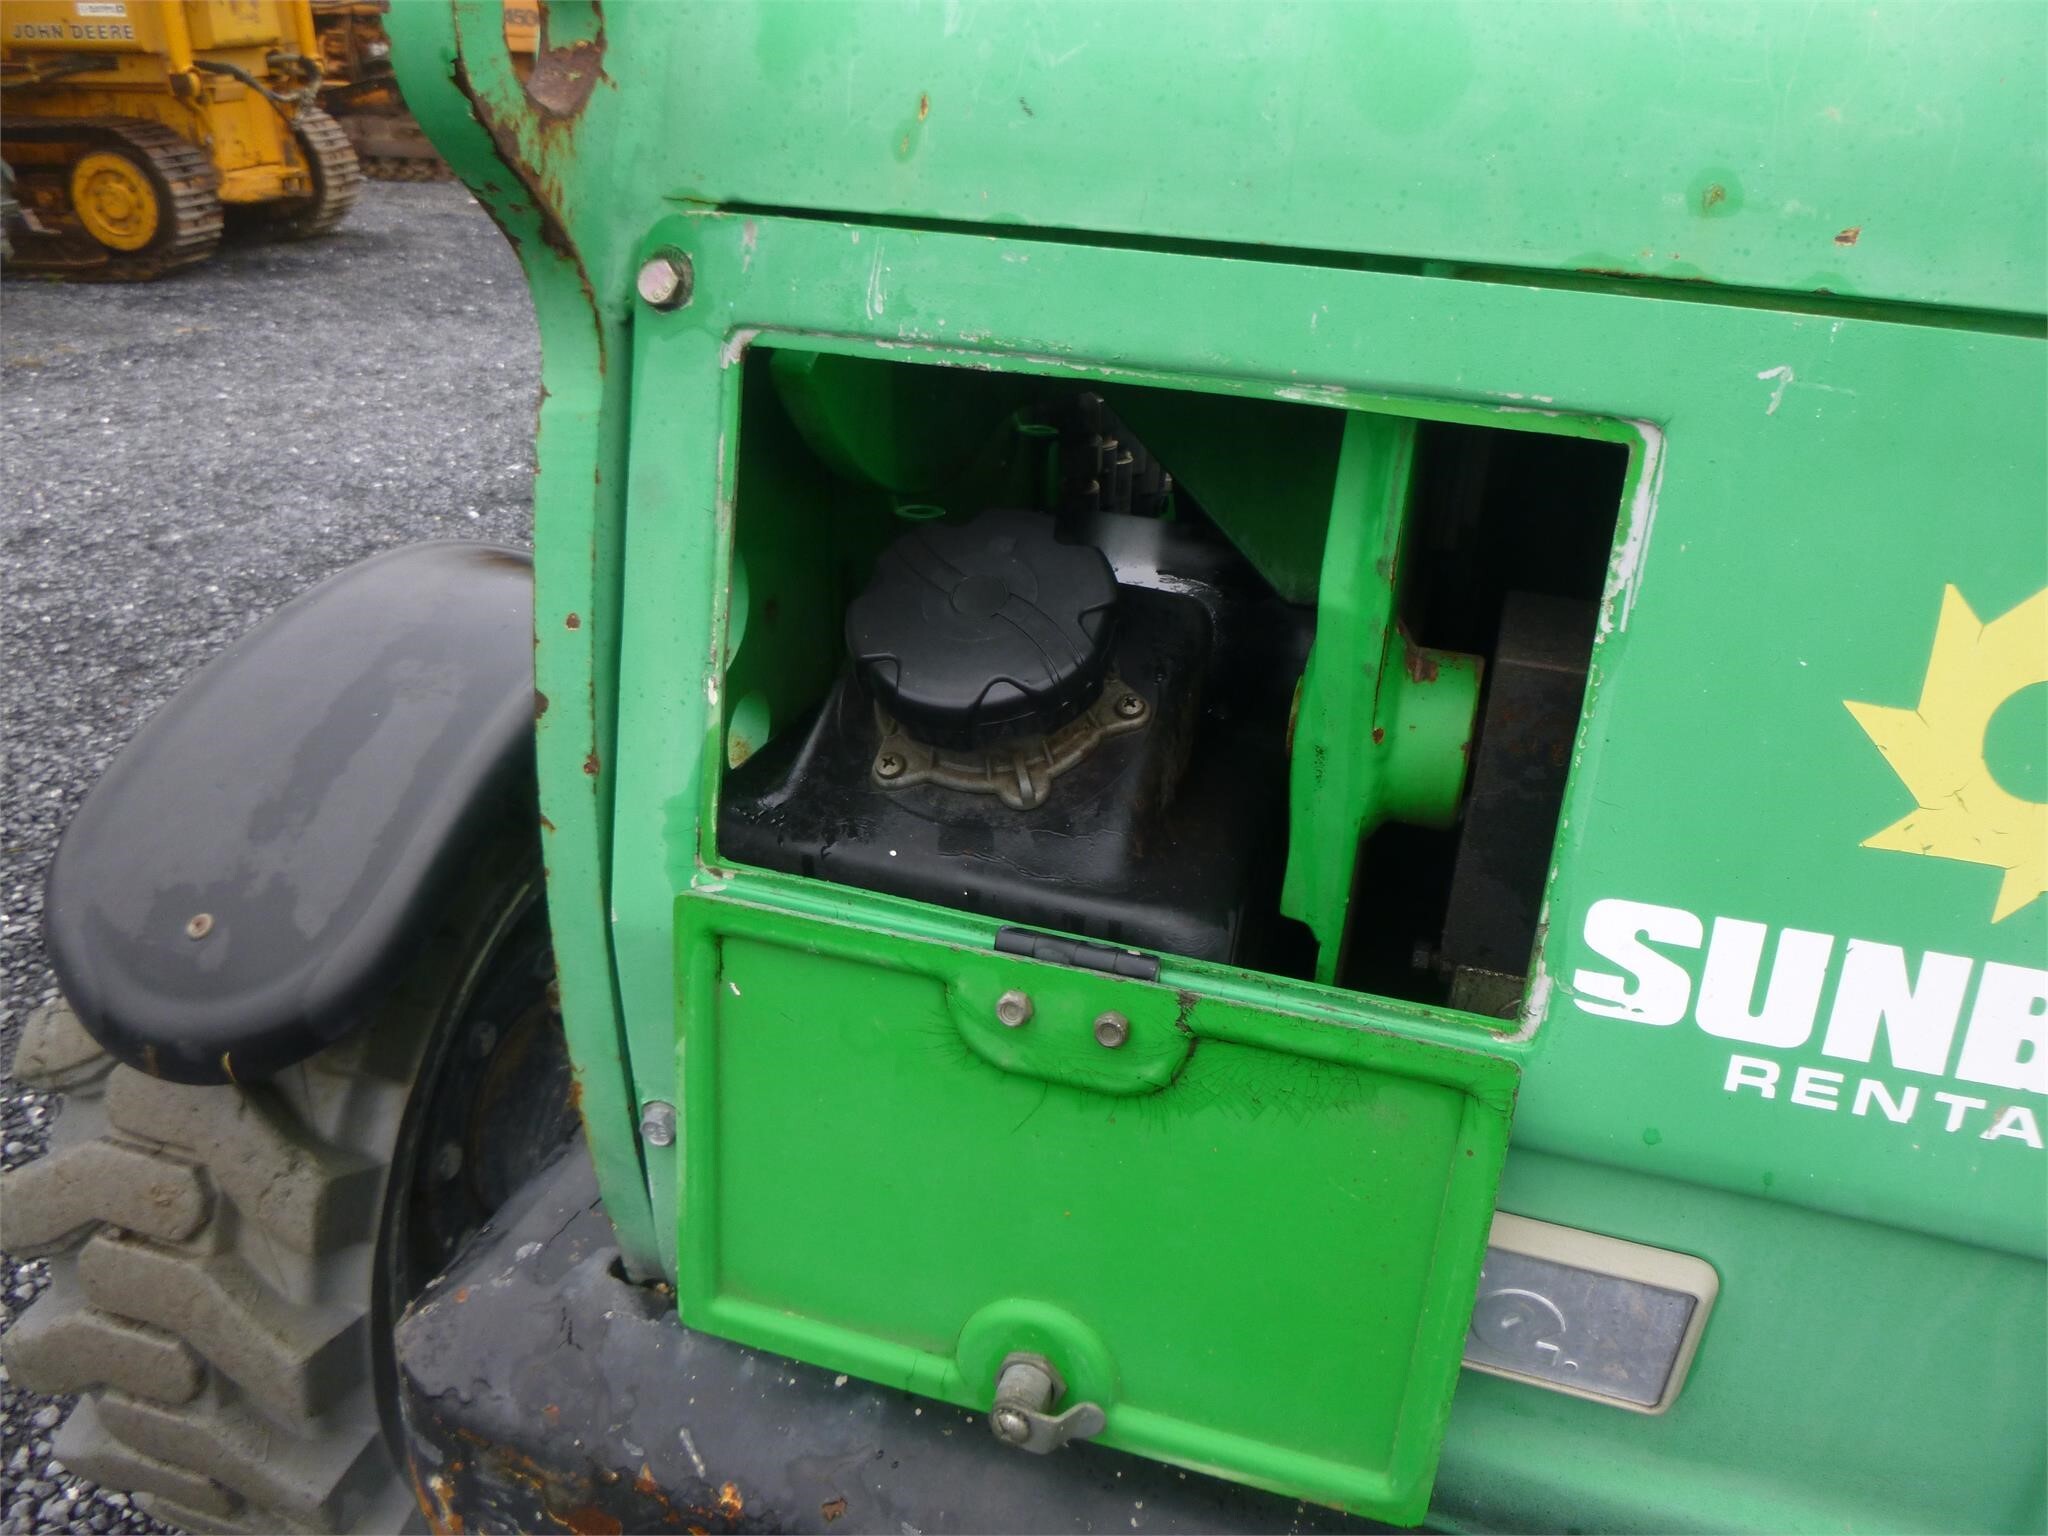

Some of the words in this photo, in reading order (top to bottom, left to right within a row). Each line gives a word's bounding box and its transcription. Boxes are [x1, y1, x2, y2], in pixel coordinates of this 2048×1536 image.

[13, 23, 64, 39] JOHN
[70, 23, 135, 40] DEERE
[1723, 1055, 2045, 1149] RENTA
